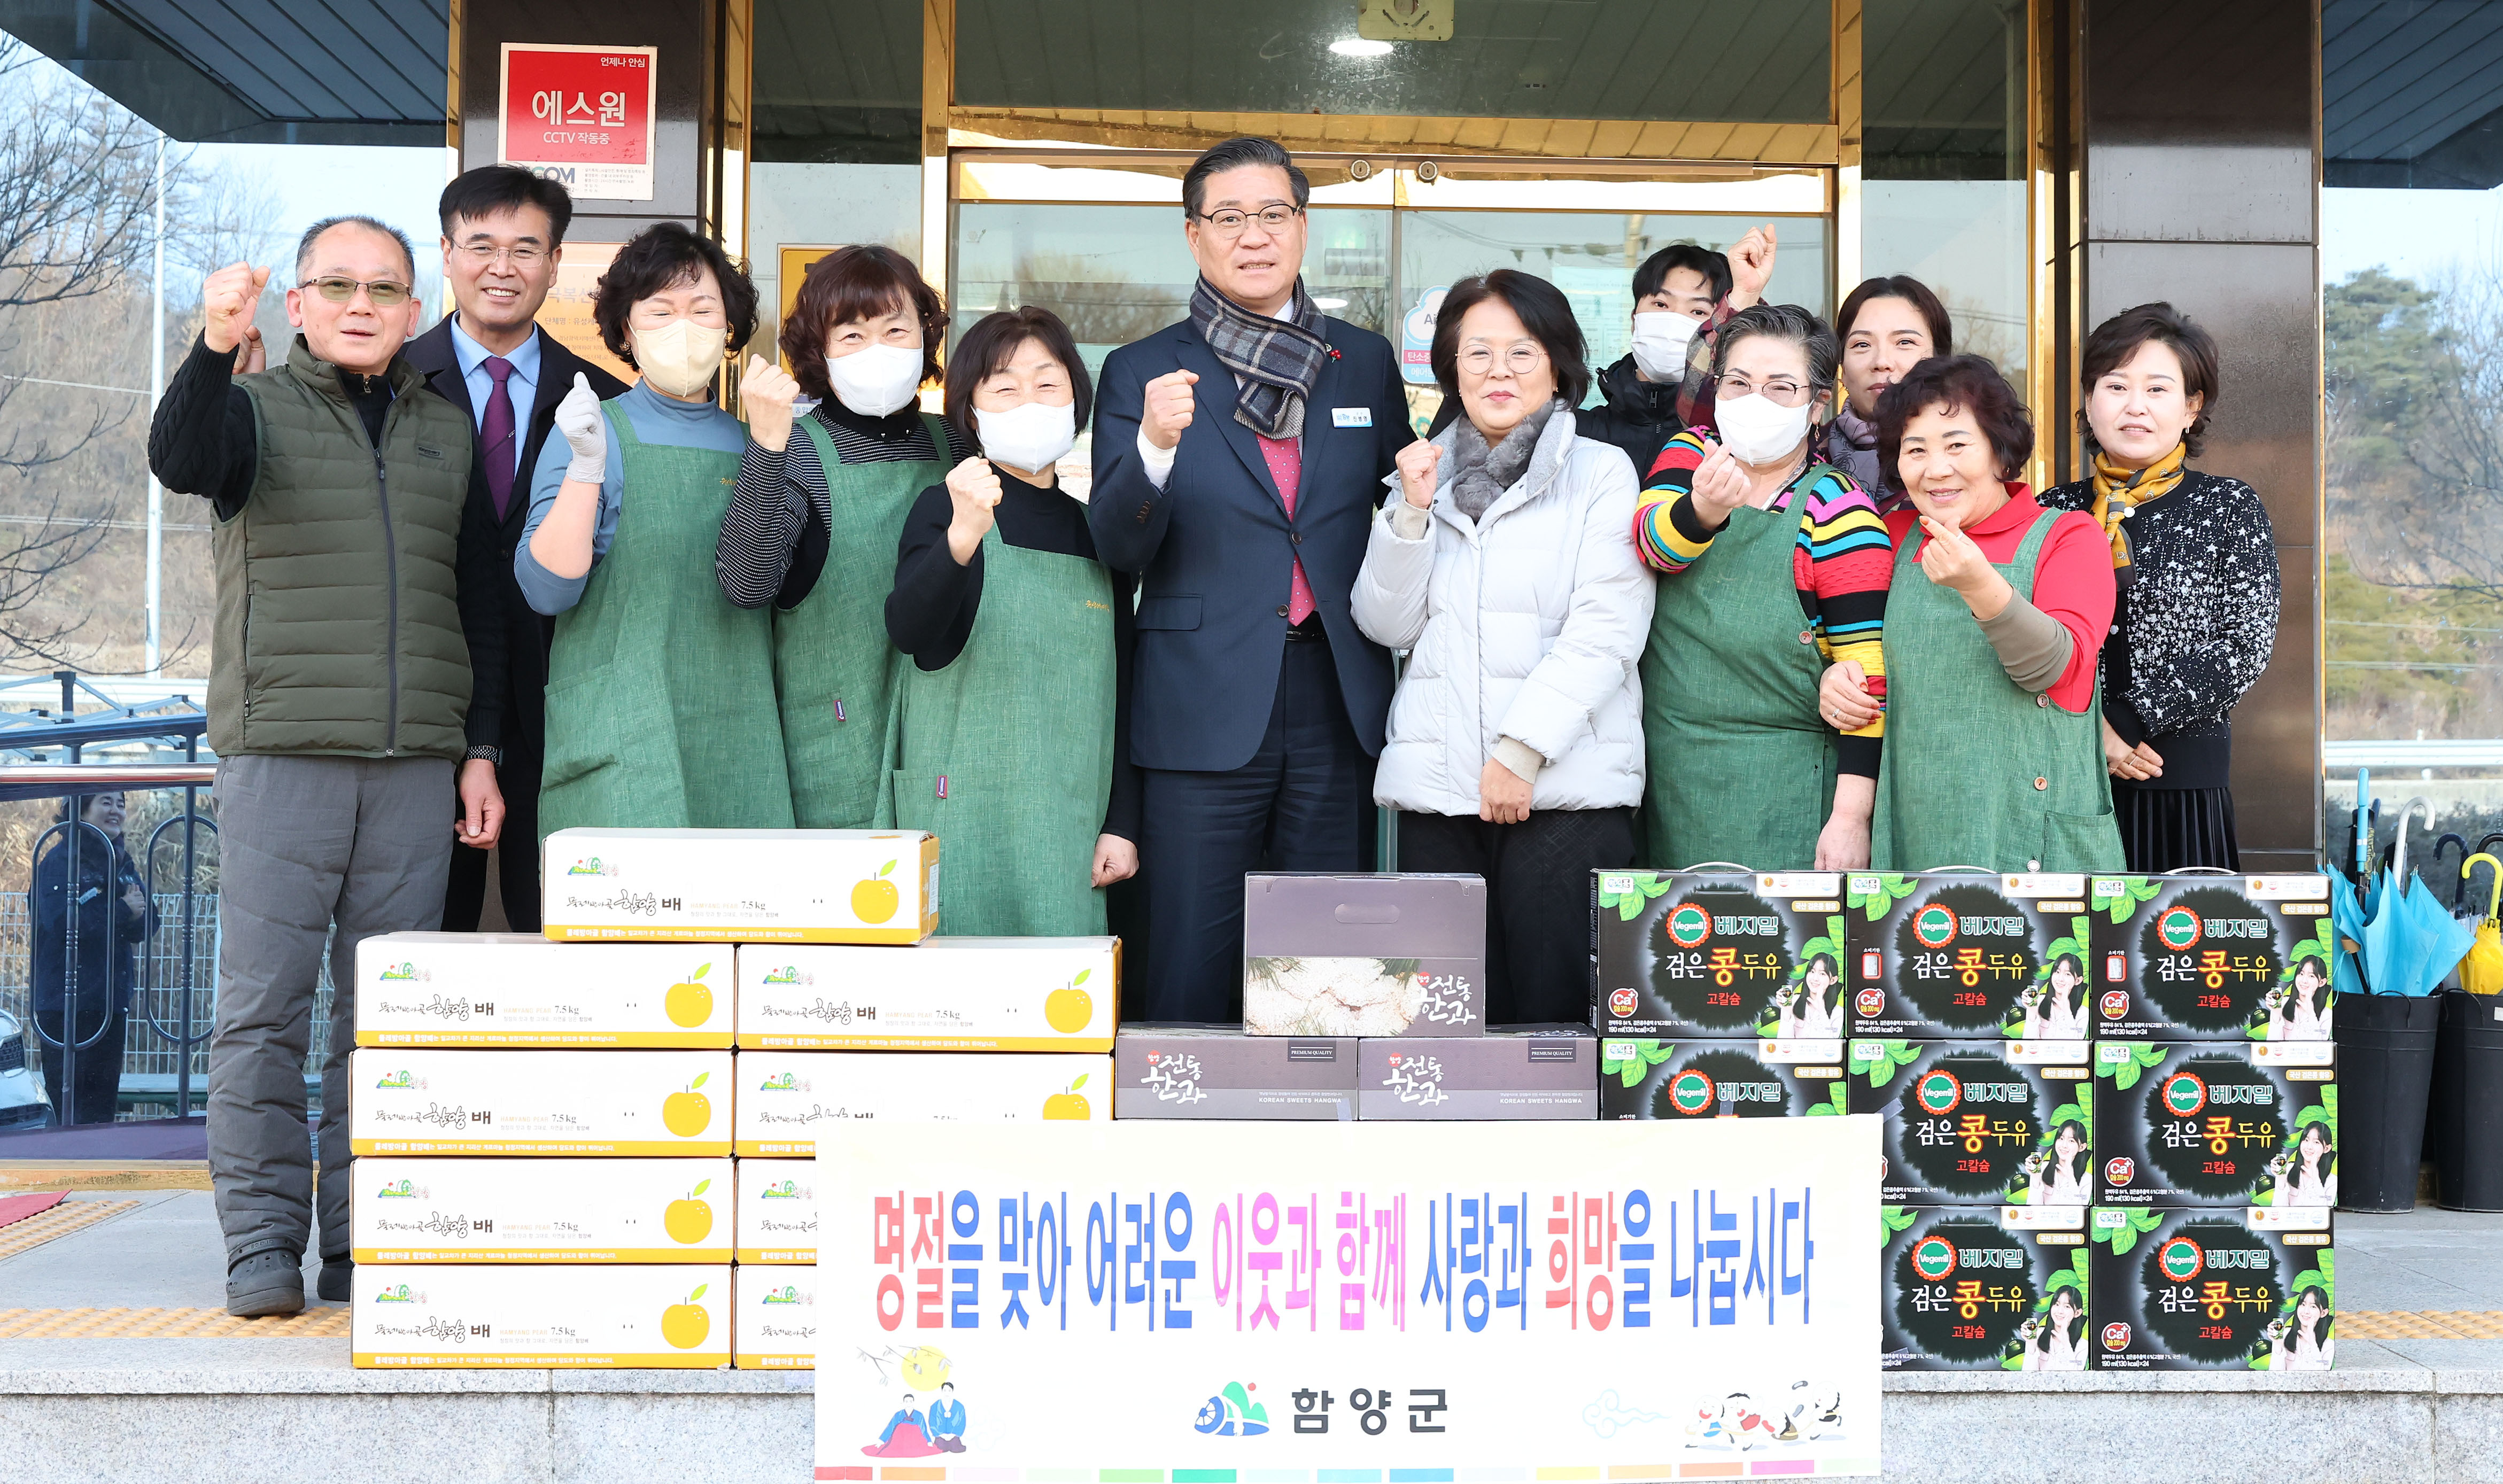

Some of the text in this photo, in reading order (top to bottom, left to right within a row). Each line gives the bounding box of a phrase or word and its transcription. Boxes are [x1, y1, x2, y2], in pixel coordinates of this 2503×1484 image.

[601, 57, 645, 67] 언제나 안심
[532, 90, 625, 127] 에스원
[543, 131, 610, 144] CCTV 작동중
[662, 898, 680, 911] 배
[1675, 921, 1703, 931] Vegemil
[1714, 916, 1778, 936] 베지밀
[1921, 922, 1950, 931] Vegemil
[1959, 916, 2024, 936] 베지밀
[2165, 924, 2194, 934] Vegemil
[2204, 919, 2267, 938] 베지밀
[1428, 974, 1473, 1001] 전통
[1411, 986, 1477, 1025] 한과
[1707, 992, 1741, 1006] 고칼슘
[1952, 992, 1986, 1006] 고칼슘
[2197, 994, 2230, 1008] 고칼슘
[475, 1003, 493, 1015] 배
[857, 1007, 875, 1020] 배
[1158, 1053, 1204, 1081] 전통
[1400, 1055, 1445, 1083] 전통
[1141, 1066, 1207, 1105] 한과
[1382, 1068, 1449, 1106] 한과
[1716, 1083, 1781, 1102] 베지밀
[1963, 1083, 2027, 1102] 베지밀
[1677, 1088, 1706, 1098] Vegemil
[1924, 1088, 1954, 1098] Vegemil
[2170, 1090, 2199, 1100] Vegemil
[2209, 1085, 2273, 1105] 베지밀
[472, 1111, 491, 1124] 배
[1956, 1159, 1990, 1172] 고칼슘
[2202, 1161, 2236, 1174] 고칼슘
[474, 1219, 492, 1232] 배
[875, 1187, 1814, 1333] 명절을 맞아 어려운 이웃과 함께 사랑과 희망을 나눕시다
[1920, 1254, 1949, 1264] Vegemil
[1959, 1249, 2023, 1269] 베지밀
[2167, 1255, 2196, 1265] Vegemil
[2205, 1250, 2269, 1269] 베지밀
[471, 1325, 490, 1338] 배
[1951, 1325, 1986, 1339] 고칼슘
[2199, 1326, 2233, 1339] 고칼슘
